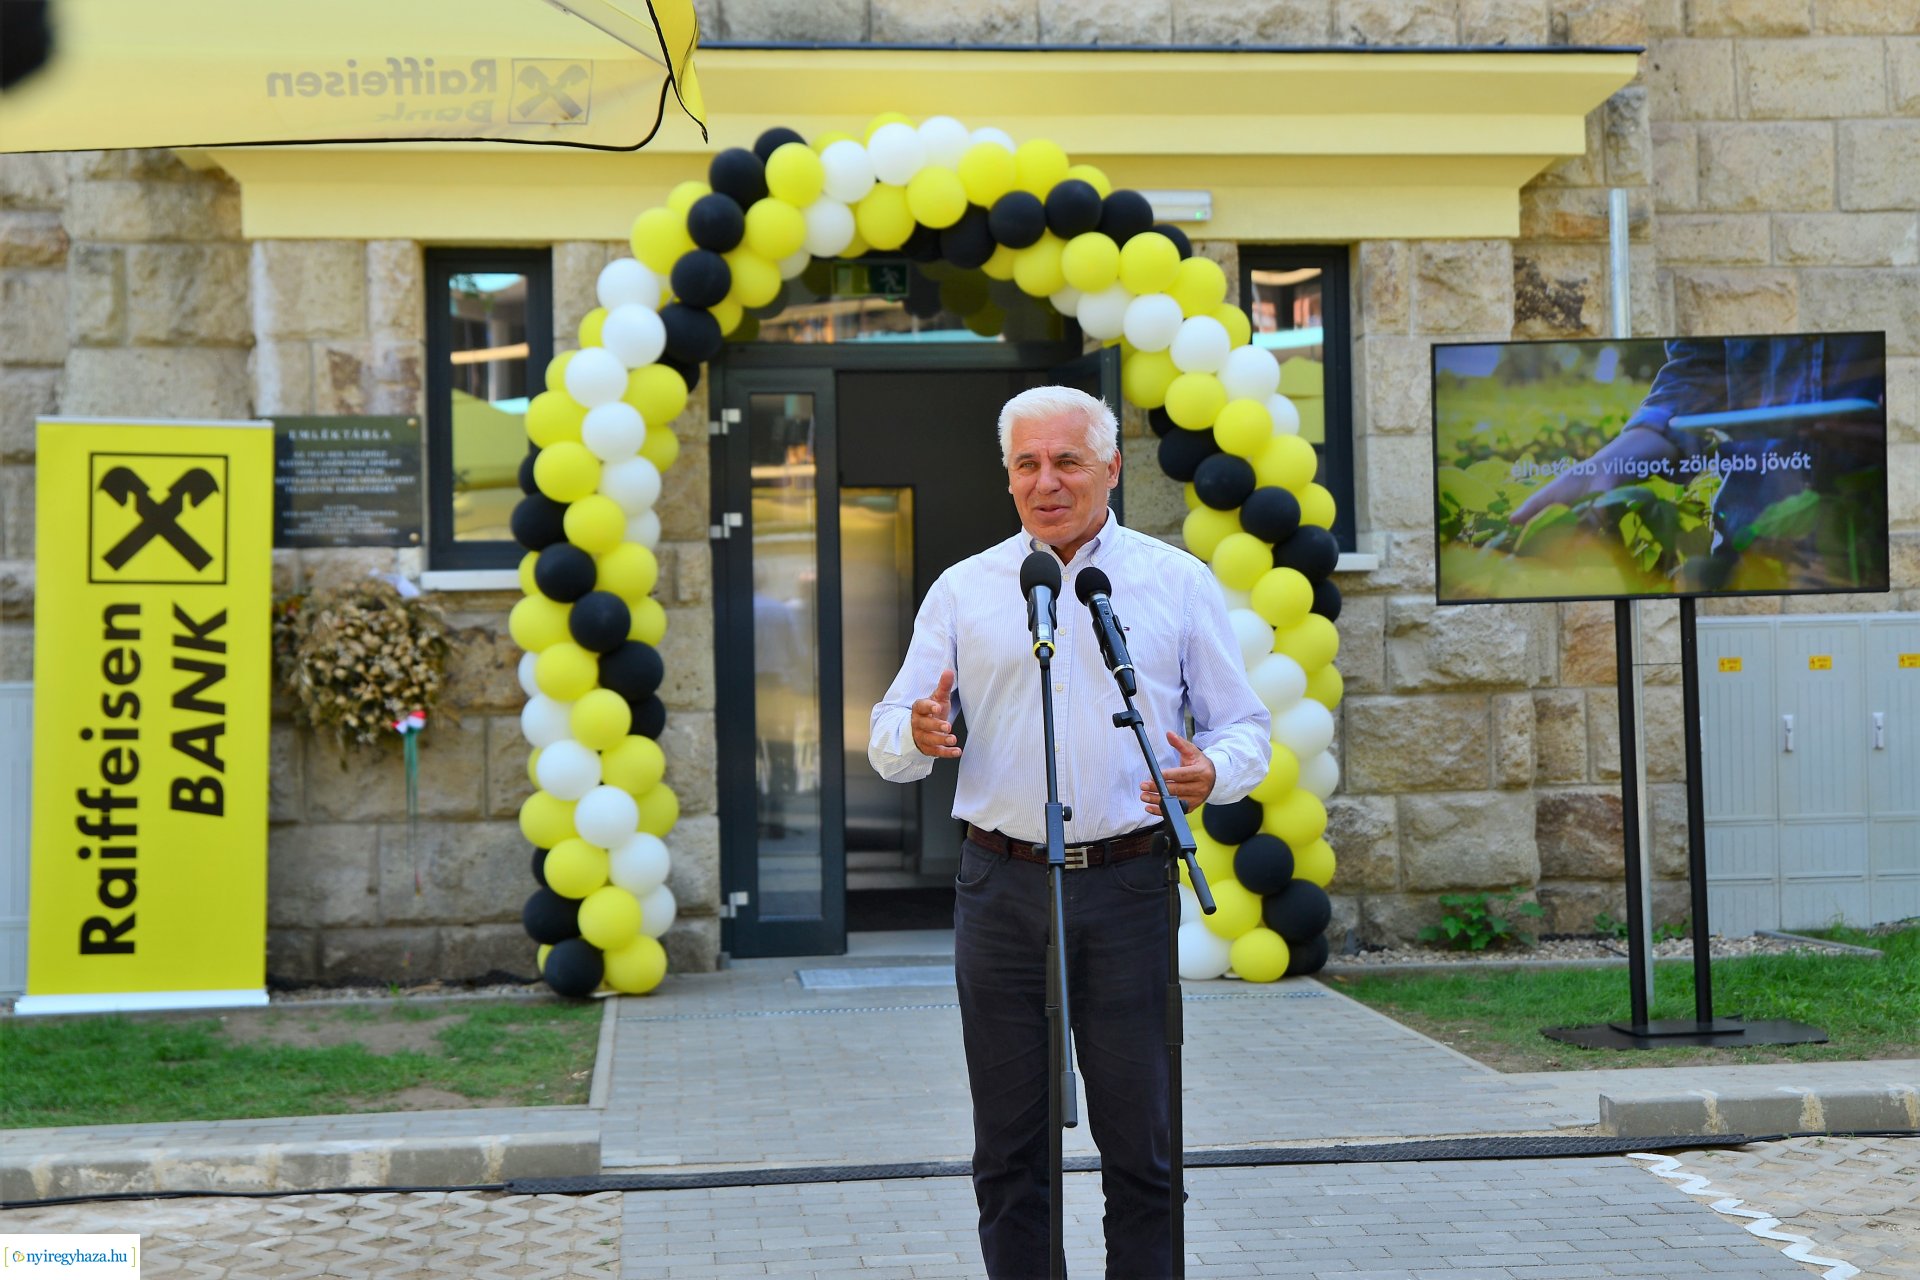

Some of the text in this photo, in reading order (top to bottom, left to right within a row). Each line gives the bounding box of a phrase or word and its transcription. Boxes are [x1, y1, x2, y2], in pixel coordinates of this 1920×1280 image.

[288, 428, 392, 441] EMLÉKTÁBLA
[1602, 456, 1675, 479] világot,
[1679, 450, 1757, 473] zöldebb
[1760, 451, 1811, 475] jövőt
[170, 602, 228, 816] BANK
[75, 603, 141, 955] Raiffeisen
